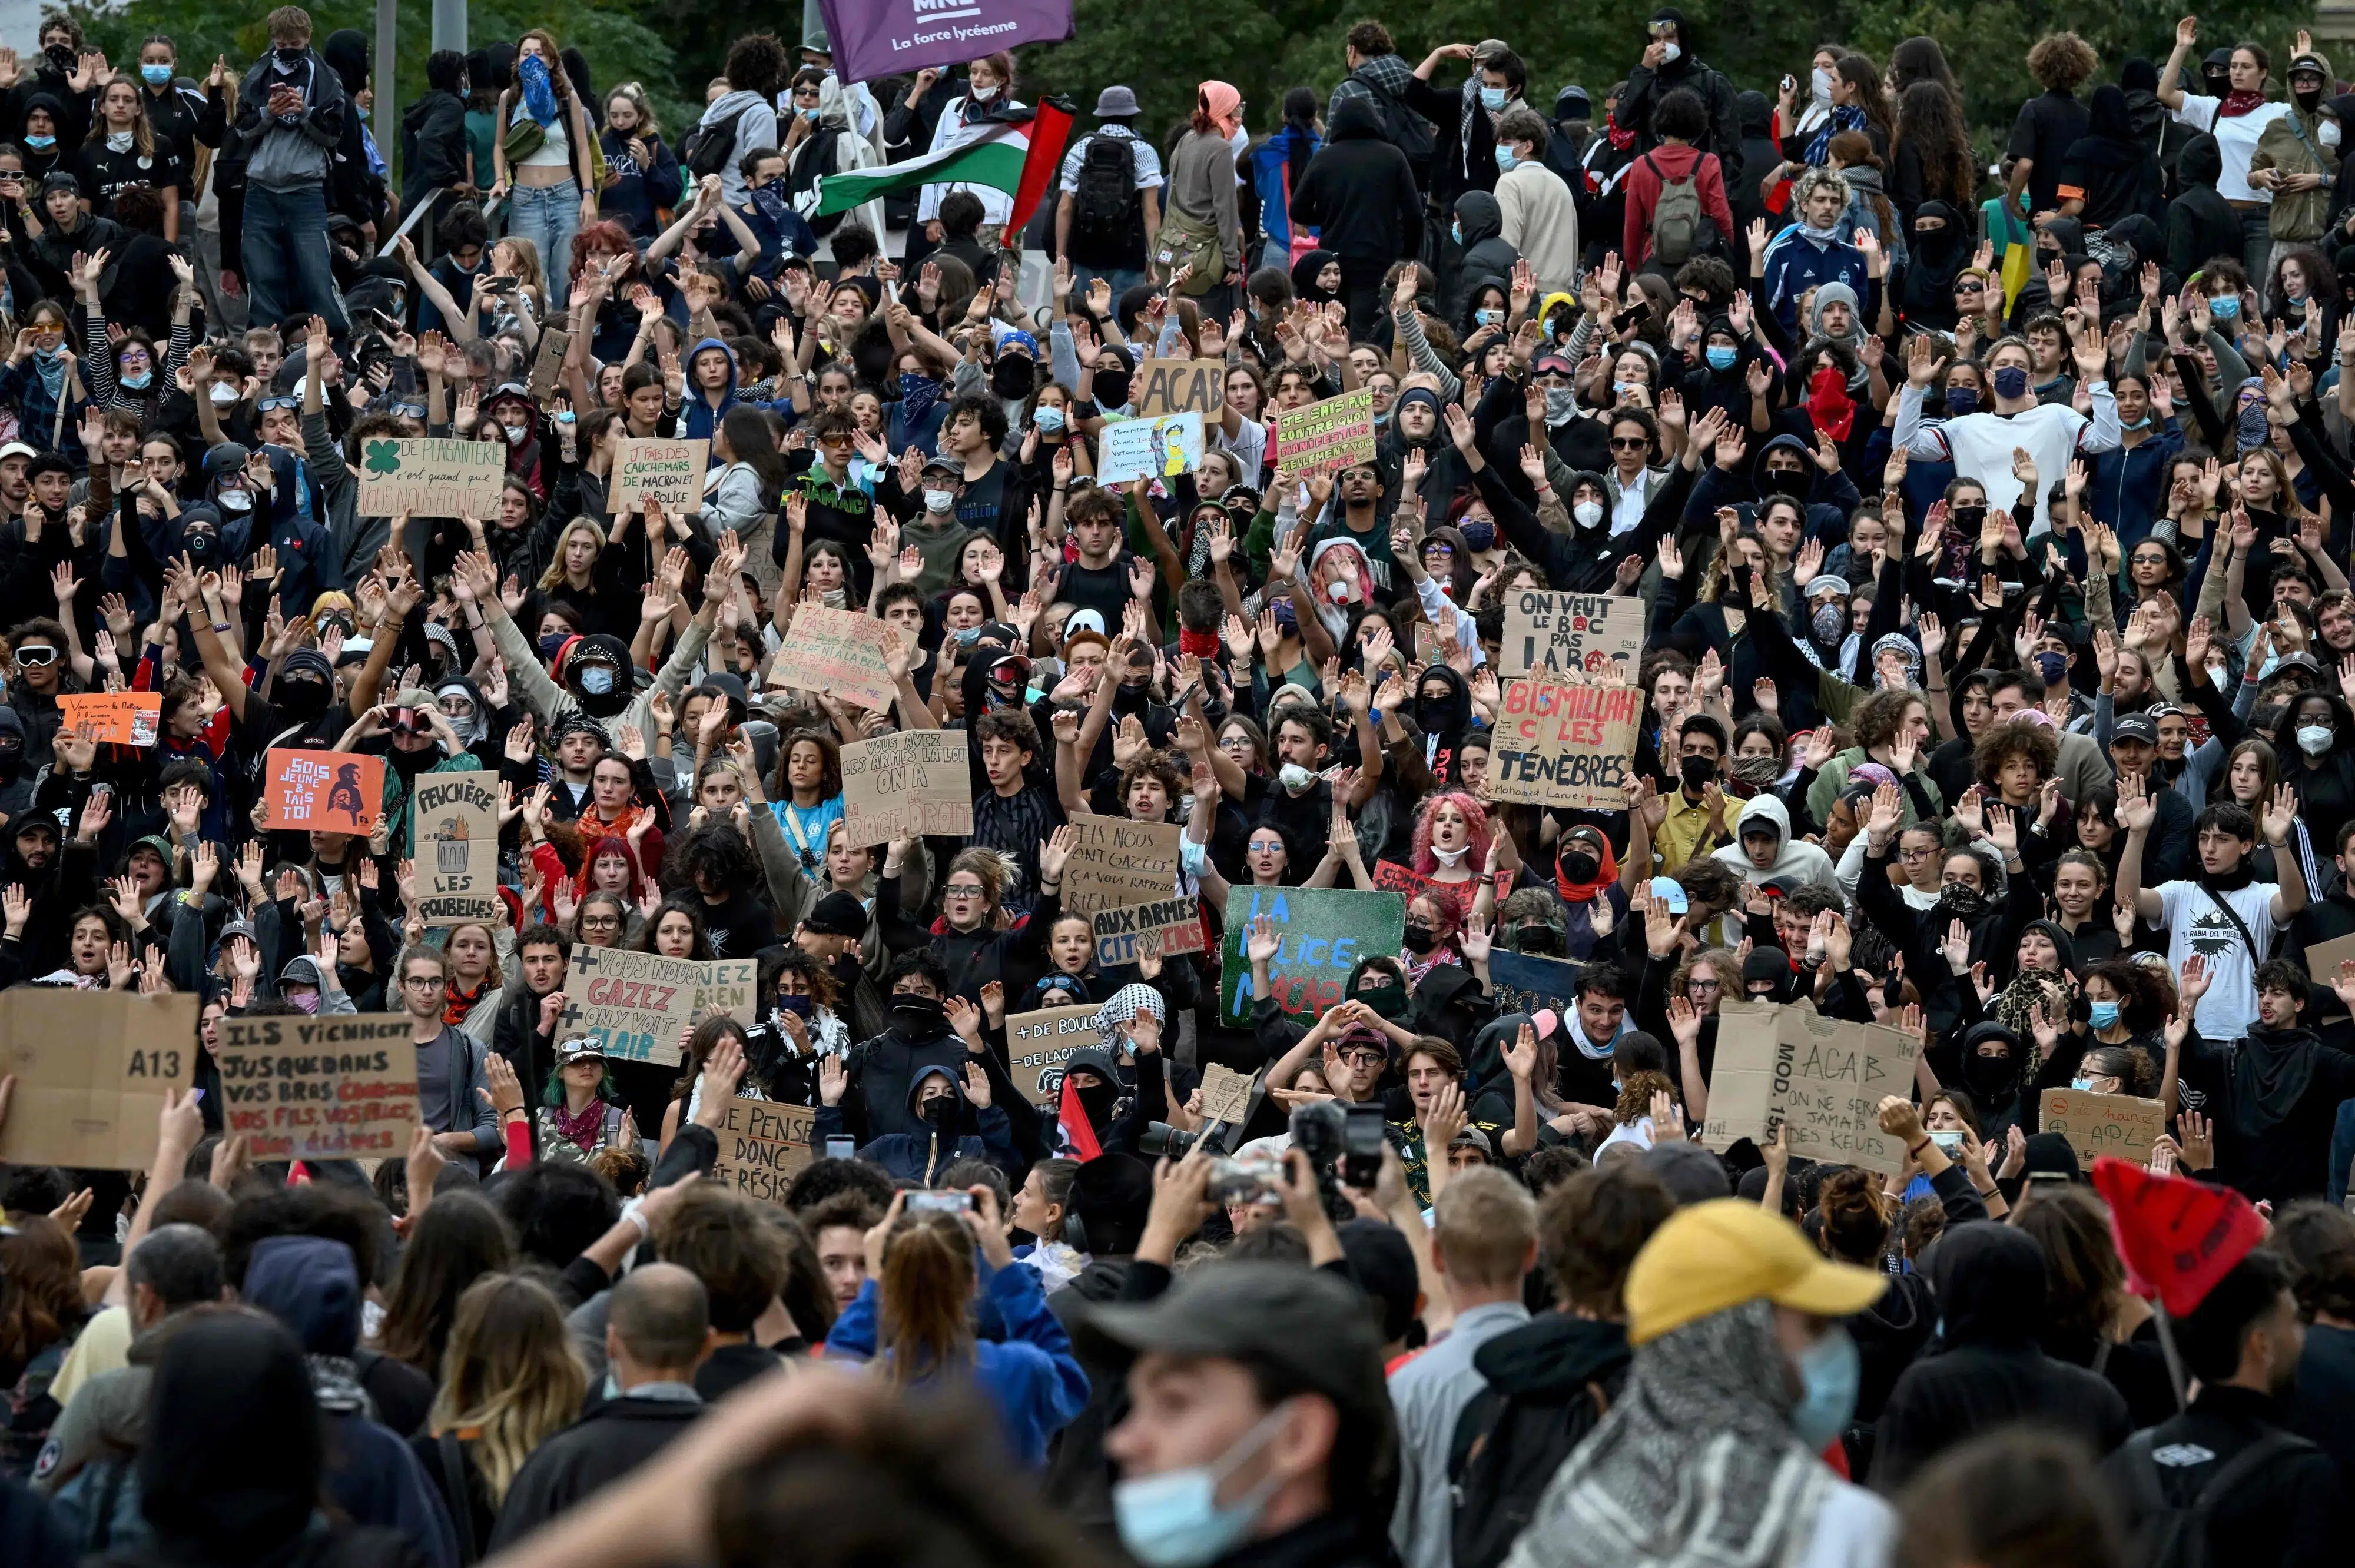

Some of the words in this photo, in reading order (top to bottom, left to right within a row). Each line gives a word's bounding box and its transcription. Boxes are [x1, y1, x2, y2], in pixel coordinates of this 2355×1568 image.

[891, 39, 912, 51] La
[914, 30, 952, 45] force
[953, 21, 1017, 42] lycéenne
[1141, 367, 1223, 413] ACAB
[1281, 413, 1305, 428] JE
[1348, 391, 1374, 410] PLUS
[1278, 419, 1334, 443] CONTRE
[1338, 408, 1367, 426] QUOI
[401, 440, 419, 457] DE
[1281, 424, 1369, 457] MANIFESTER
[665, 447, 689, 460] DES
[1281, 443, 1349, 472] TELLEMENT
[1349, 437, 1375, 451] VOUS
[396, 467, 425, 480] c'est
[429, 470, 461, 487] quand
[468, 473, 491, 487] que
[624, 461, 690, 474] CAUCHEMARS
[622, 476, 639, 487] DE
[642, 475, 682, 487] MACRON
[683, 474, 694, 486] ET
[361, 485, 393, 515] VOUS
[396, 486, 433, 515] NOUS
[829, 610, 838, 620] 2
[1520, 593, 1553, 615] ON
[1559, 594, 1613, 618] VEUT
[801, 617, 824, 632] PAS
[827, 623, 843, 634] DE
[846, 624, 877, 642] PROF
[1533, 616, 1550, 629] LE
[1558, 616, 1604, 635] BAC
[815, 633, 840, 646] PLUS
[843, 637, 857, 650] LE
[1551, 633, 1583, 647] PAS
[844, 653, 857, 665] LA
[801, 672, 815, 685] TU
[865, 687, 884, 699] ME
[1505, 682, 1637, 726] BISMILLAH
[866, 737, 898, 756] VOUS
[905, 733, 941, 748] AVEZ
[1519, 719, 1537, 738] C
[1558, 720, 1605, 746] LES
[291, 758, 330, 779] SOIS
[843, 756, 867, 776] LES
[871, 747, 917, 771] ARMES
[922, 747, 940, 763] LA
[943, 747, 964, 763] LOI
[1497, 745, 1627, 788] TÉNÈBRES
[280, 767, 319, 788] JEUNE
[295, 782, 304, 793] &
[876, 766, 907, 795] ON
[912, 762, 928, 788] A
[284, 790, 314, 805] TAIS
[418, 778, 496, 815] PEUCHÈRE
[907, 790, 921, 805] LE
[283, 805, 310, 820] TOI
[846, 803, 859, 817] LA
[909, 802, 973, 835] DROIT
[847, 808, 903, 848] RAGE
[1113, 827, 1154, 848] NOUS
[1072, 848, 1106, 863] ONT
[433, 875, 473, 893] LES
[1096, 872, 1124, 883] VOUS
[1069, 891, 1111, 911] RIEN
[1094, 909, 1136, 936] AUX
[1139, 897, 1199, 929] ARMES
[1099, 923, 1201, 964] CITOYENS
[2223, 931, 2243, 941] PUEBLO
[598, 949, 650, 979] VOUS
[652, 959, 703, 986] NOUS
[588, 978, 676, 1012] GAZEZ
[227, 1021, 283, 1047] ILS
[632, 1012, 678, 1036] VOIT
[1033, 1021, 1053, 1038] DE
[127, 1048, 180, 1078] A13
[1023, 1053, 1043, 1068] DE
[1772, 1042, 1795, 1097] MOD.
[1802, 1044, 1886, 1083] ACAB
[225, 1082, 271, 1103] VOS
[279, 1080, 333, 1102] BRAS
[1788, 1090, 1809, 1107] ON
[1818, 1096, 1834, 1111] NE
[1846, 1098, 1880, 1118] SERA
[1807, 1112, 1866, 1131] JAMAIS
[1785, 1127, 1820, 1144] DES
[1830, 1130, 1885, 1155] KEUFS
[2091, 1124, 2145, 1147] APL
[735, 1137, 790, 1171] DONC
